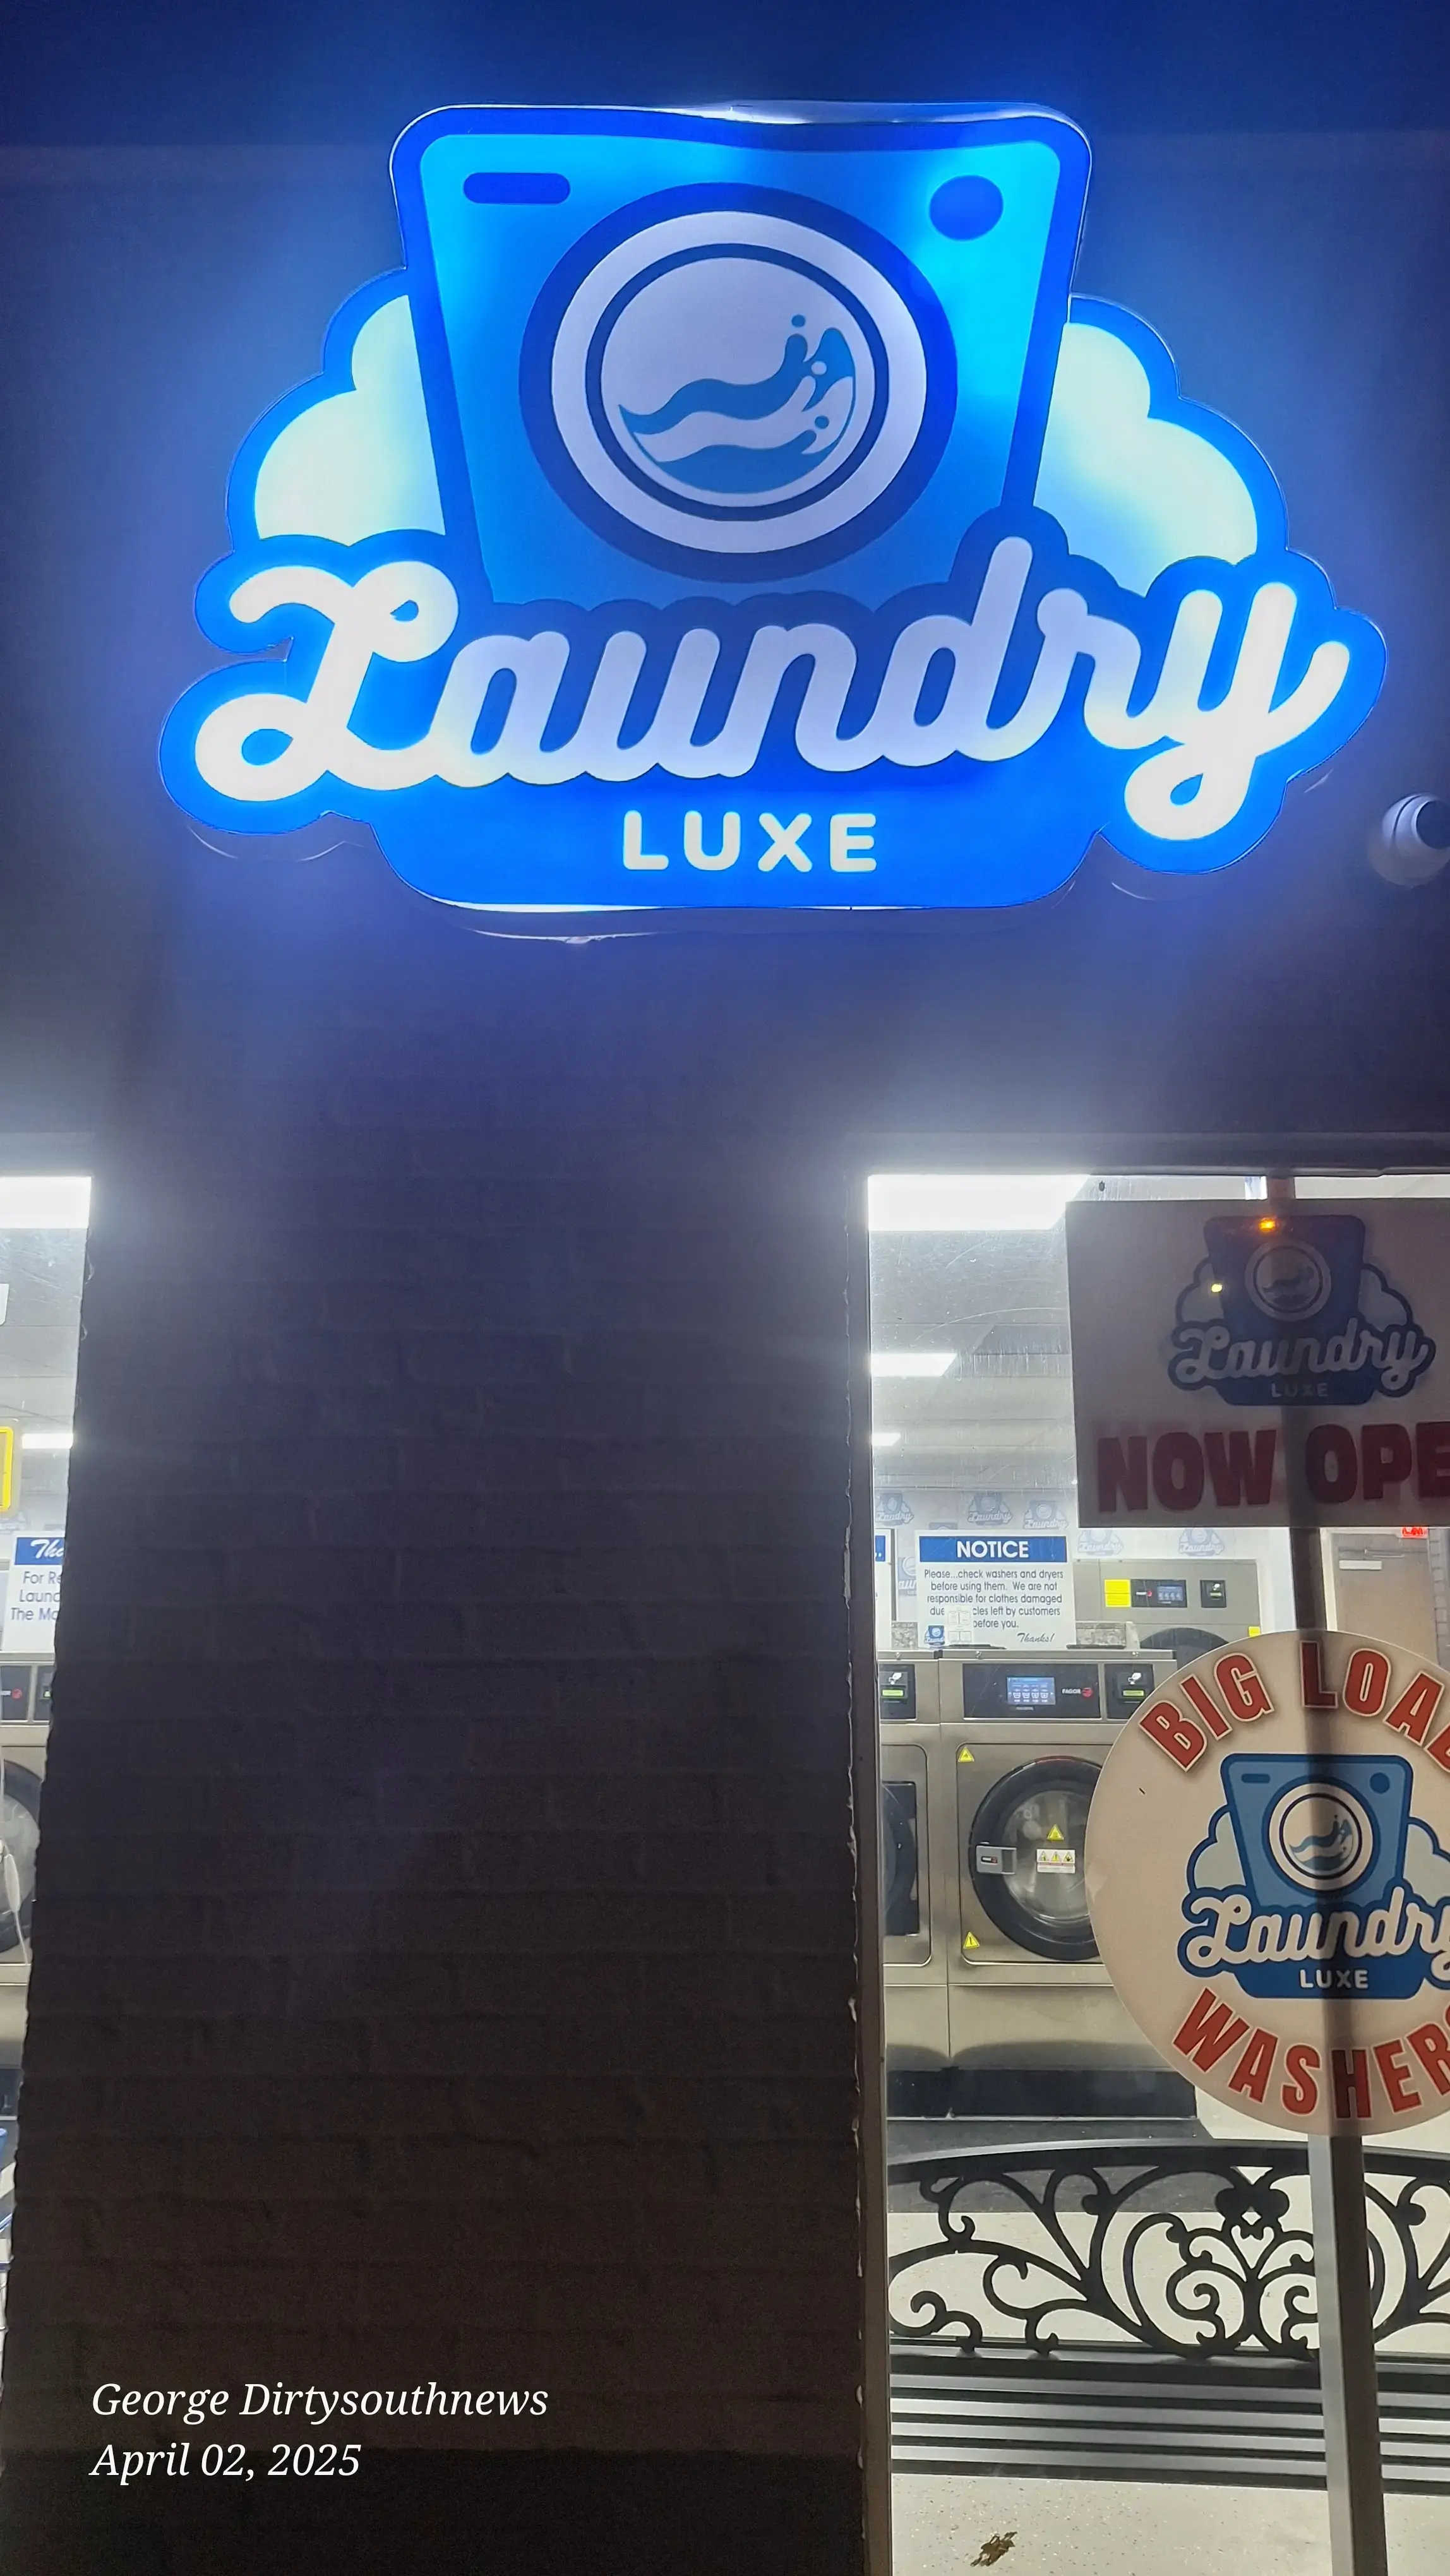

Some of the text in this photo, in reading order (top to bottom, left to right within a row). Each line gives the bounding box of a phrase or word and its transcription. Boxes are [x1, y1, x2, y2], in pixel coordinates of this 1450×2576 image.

[195, 537, 1350, 840] Laundry
[623, 811, 877, 873] LUXE
[1176, 1318, 1429, 1390] Laundry
[1271, 1382, 1328, 1398] LUXE
[1097, 1429, 1277, 1512] NOW
[957, 1541, 1029, 1558] NOTICE
[23, 1571, 44, 1584] For
[985, 1569, 1018, 1578] washers
[1020, 1569, 1036, 1578] and
[1039, 1569, 1064, 1580] dryers
[931, 1581, 1058, 1592] before using them. We are not
[927, 1593, 1062, 1605] responsible for clothes damaged
[11, 1607, 34, 1620] The
[930, 1606, 945, 1616] due
[990, 1606, 1004, 1616] left
[1005, 1606, 1016, 1618] by
[1018, 1606, 1061, 1616] customers
[1001, 1620, 1019, 1630] you.
[1017, 1632, 1056, 1643] Thanks!
[1138, 1652, 1275, 1772] BIG
[1300, 1969, 1369, 1989] LUXE
[1173, 1987, 1450, 2120] WASHER
